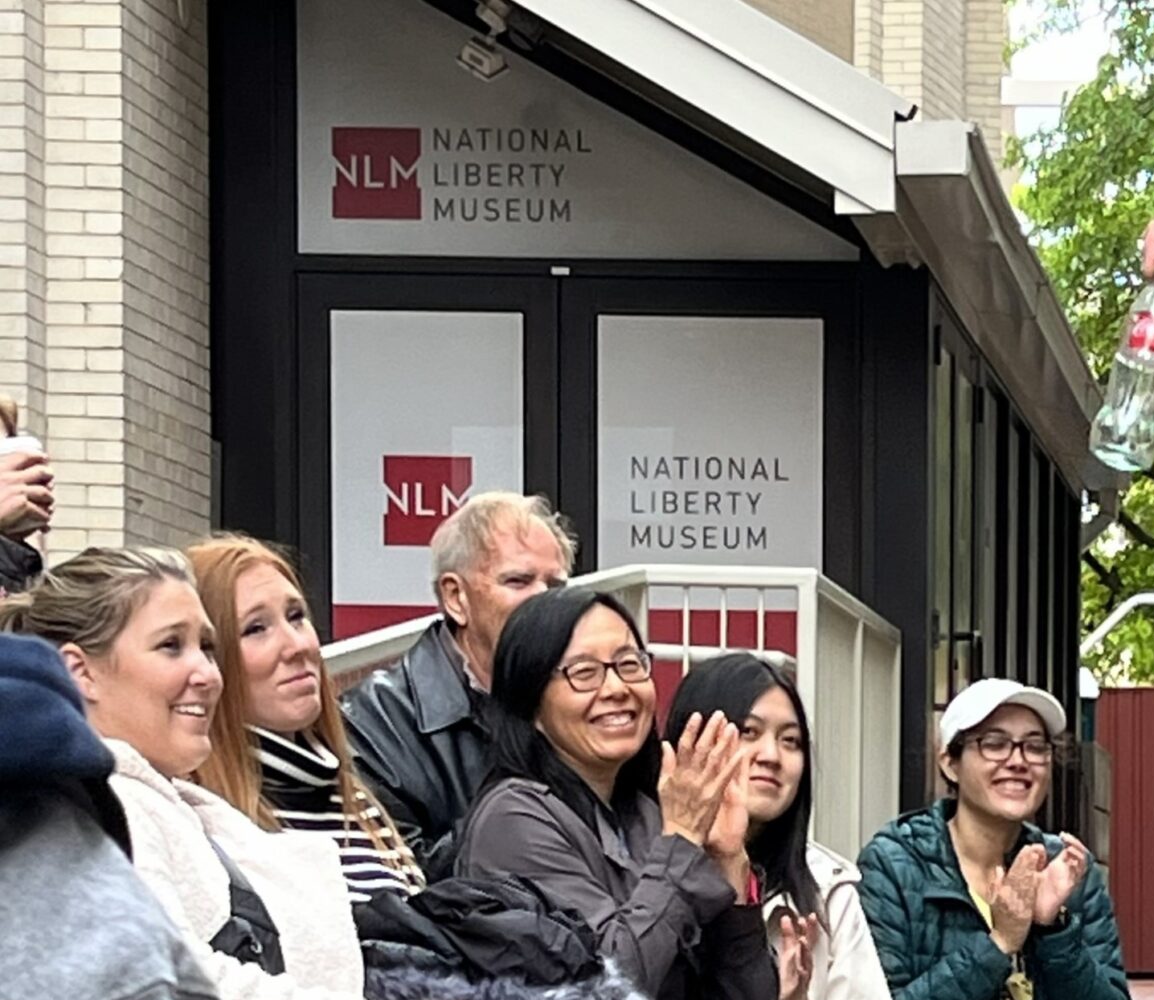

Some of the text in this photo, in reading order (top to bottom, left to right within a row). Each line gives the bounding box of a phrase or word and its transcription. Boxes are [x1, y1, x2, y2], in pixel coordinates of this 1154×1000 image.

[433, 128, 592, 153] NATIONAL
[332, 154, 421, 189] NLM
[433, 163, 565, 187] LIBERTY
[433, 198, 571, 222] MUSEUM
[631, 456, 789, 481] NATIONAL
[631, 490, 762, 515] LIBERTY
[631, 524, 767, 550] MUSEUM
